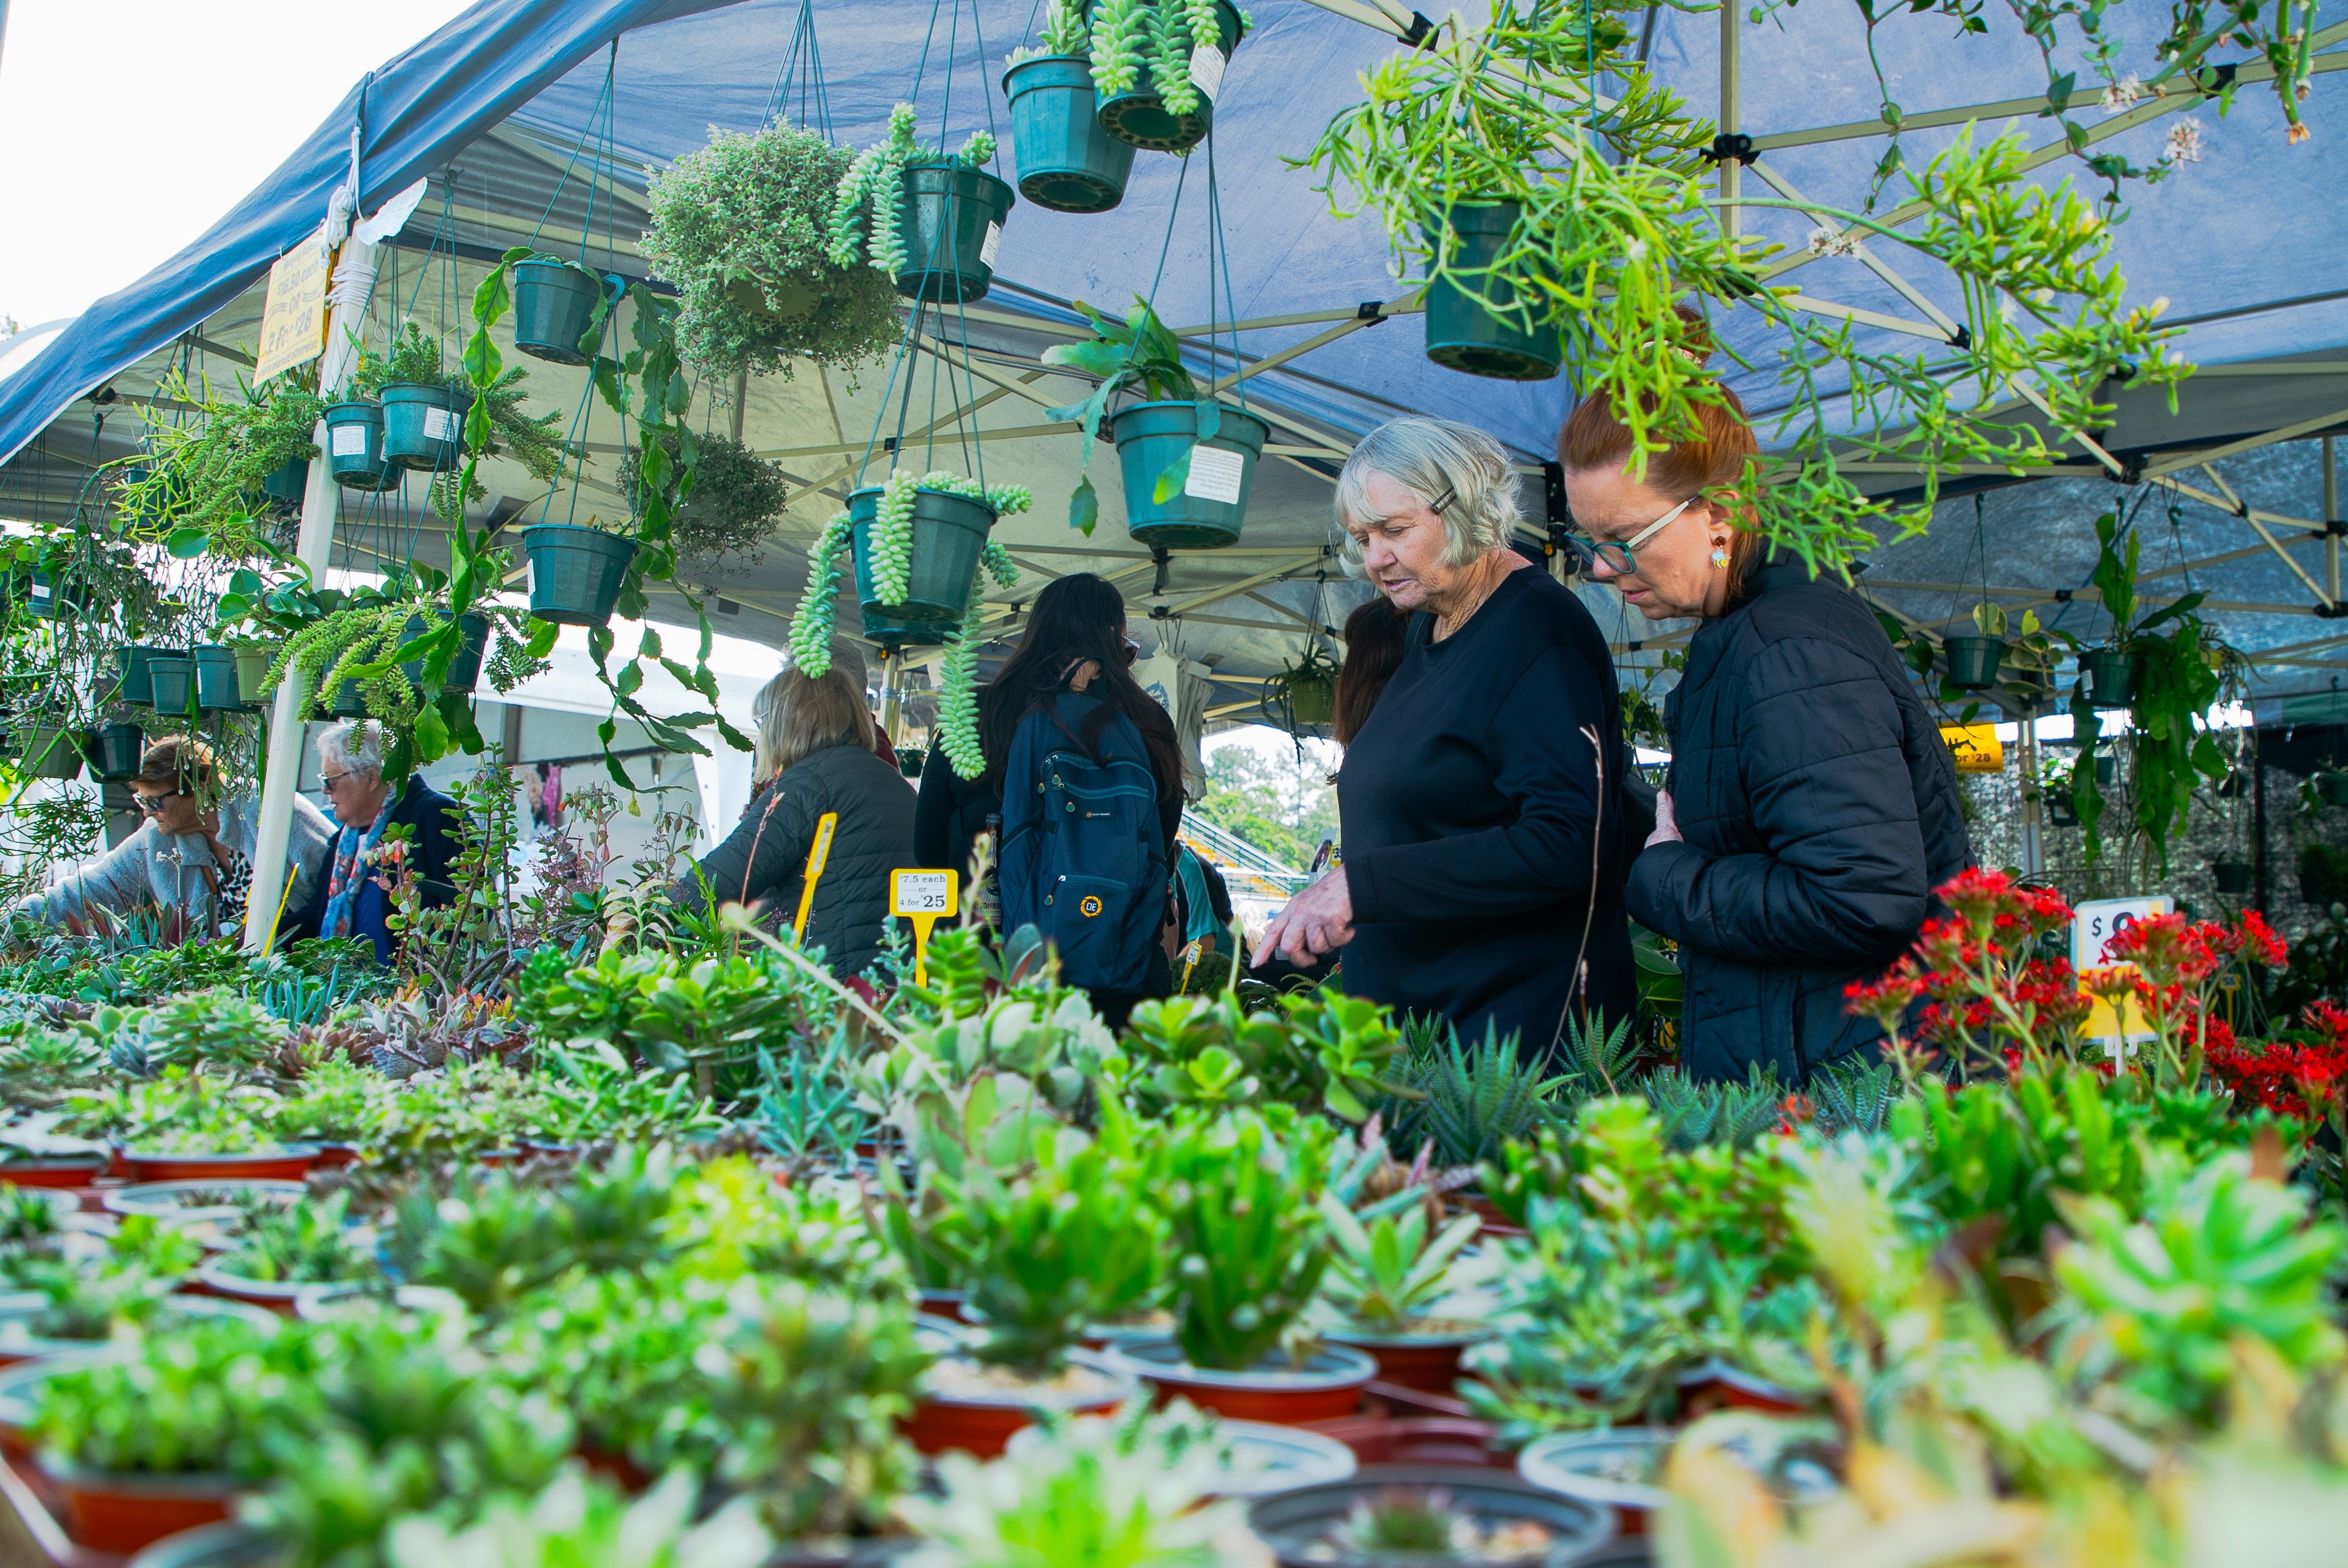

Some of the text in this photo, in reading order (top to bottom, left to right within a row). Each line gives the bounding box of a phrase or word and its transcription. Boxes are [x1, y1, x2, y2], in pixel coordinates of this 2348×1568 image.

[301, 258, 319, 283] each
[289, 292, 301, 314] OR
[268, 331, 276, 355] 2
[295, 306, 312, 337] $28
[1972, 753, 1991, 763] $28
